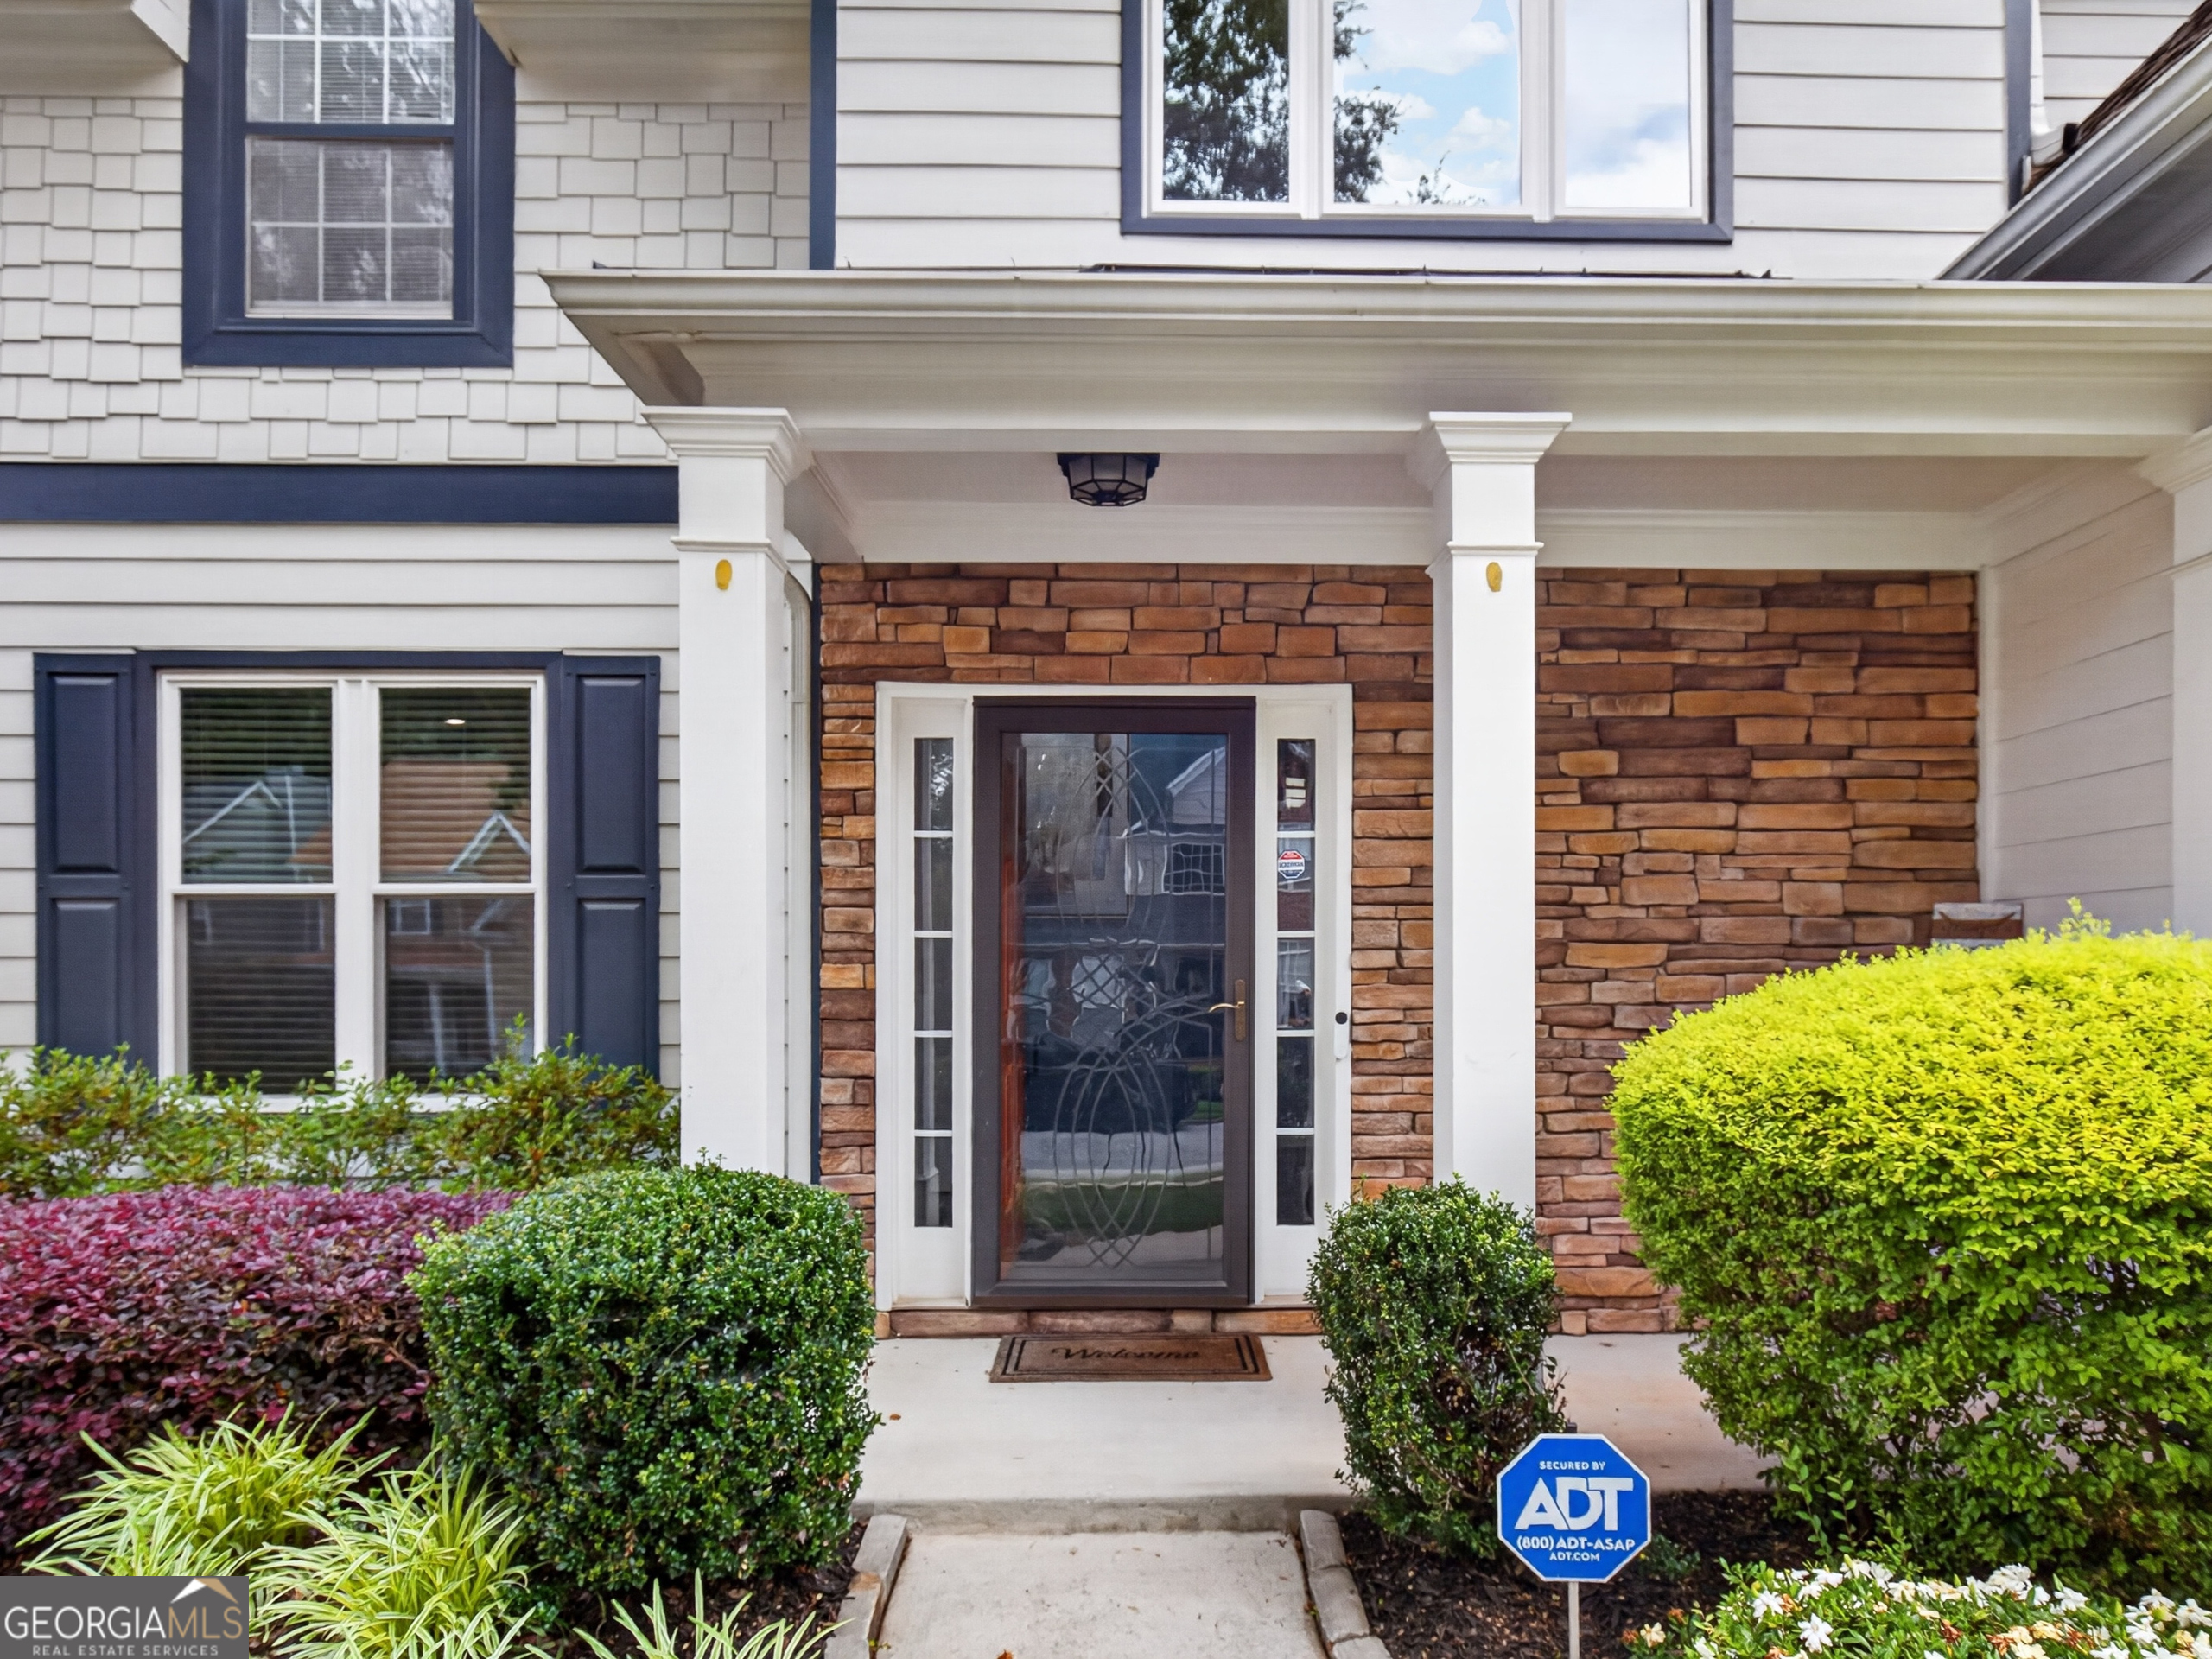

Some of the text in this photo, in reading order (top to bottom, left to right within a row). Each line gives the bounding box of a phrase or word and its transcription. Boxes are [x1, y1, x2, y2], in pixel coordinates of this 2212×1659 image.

[1052, 1346, 1201, 1361] Welcome
[1539, 1460, 1606, 1471] SECURED BY
[1514, 1477, 1634, 1531] ADT
[1516, 1535, 1636, 1551] (800) ADT-ASAP
[1549, 1552, 1600, 1561] ADT.COM
